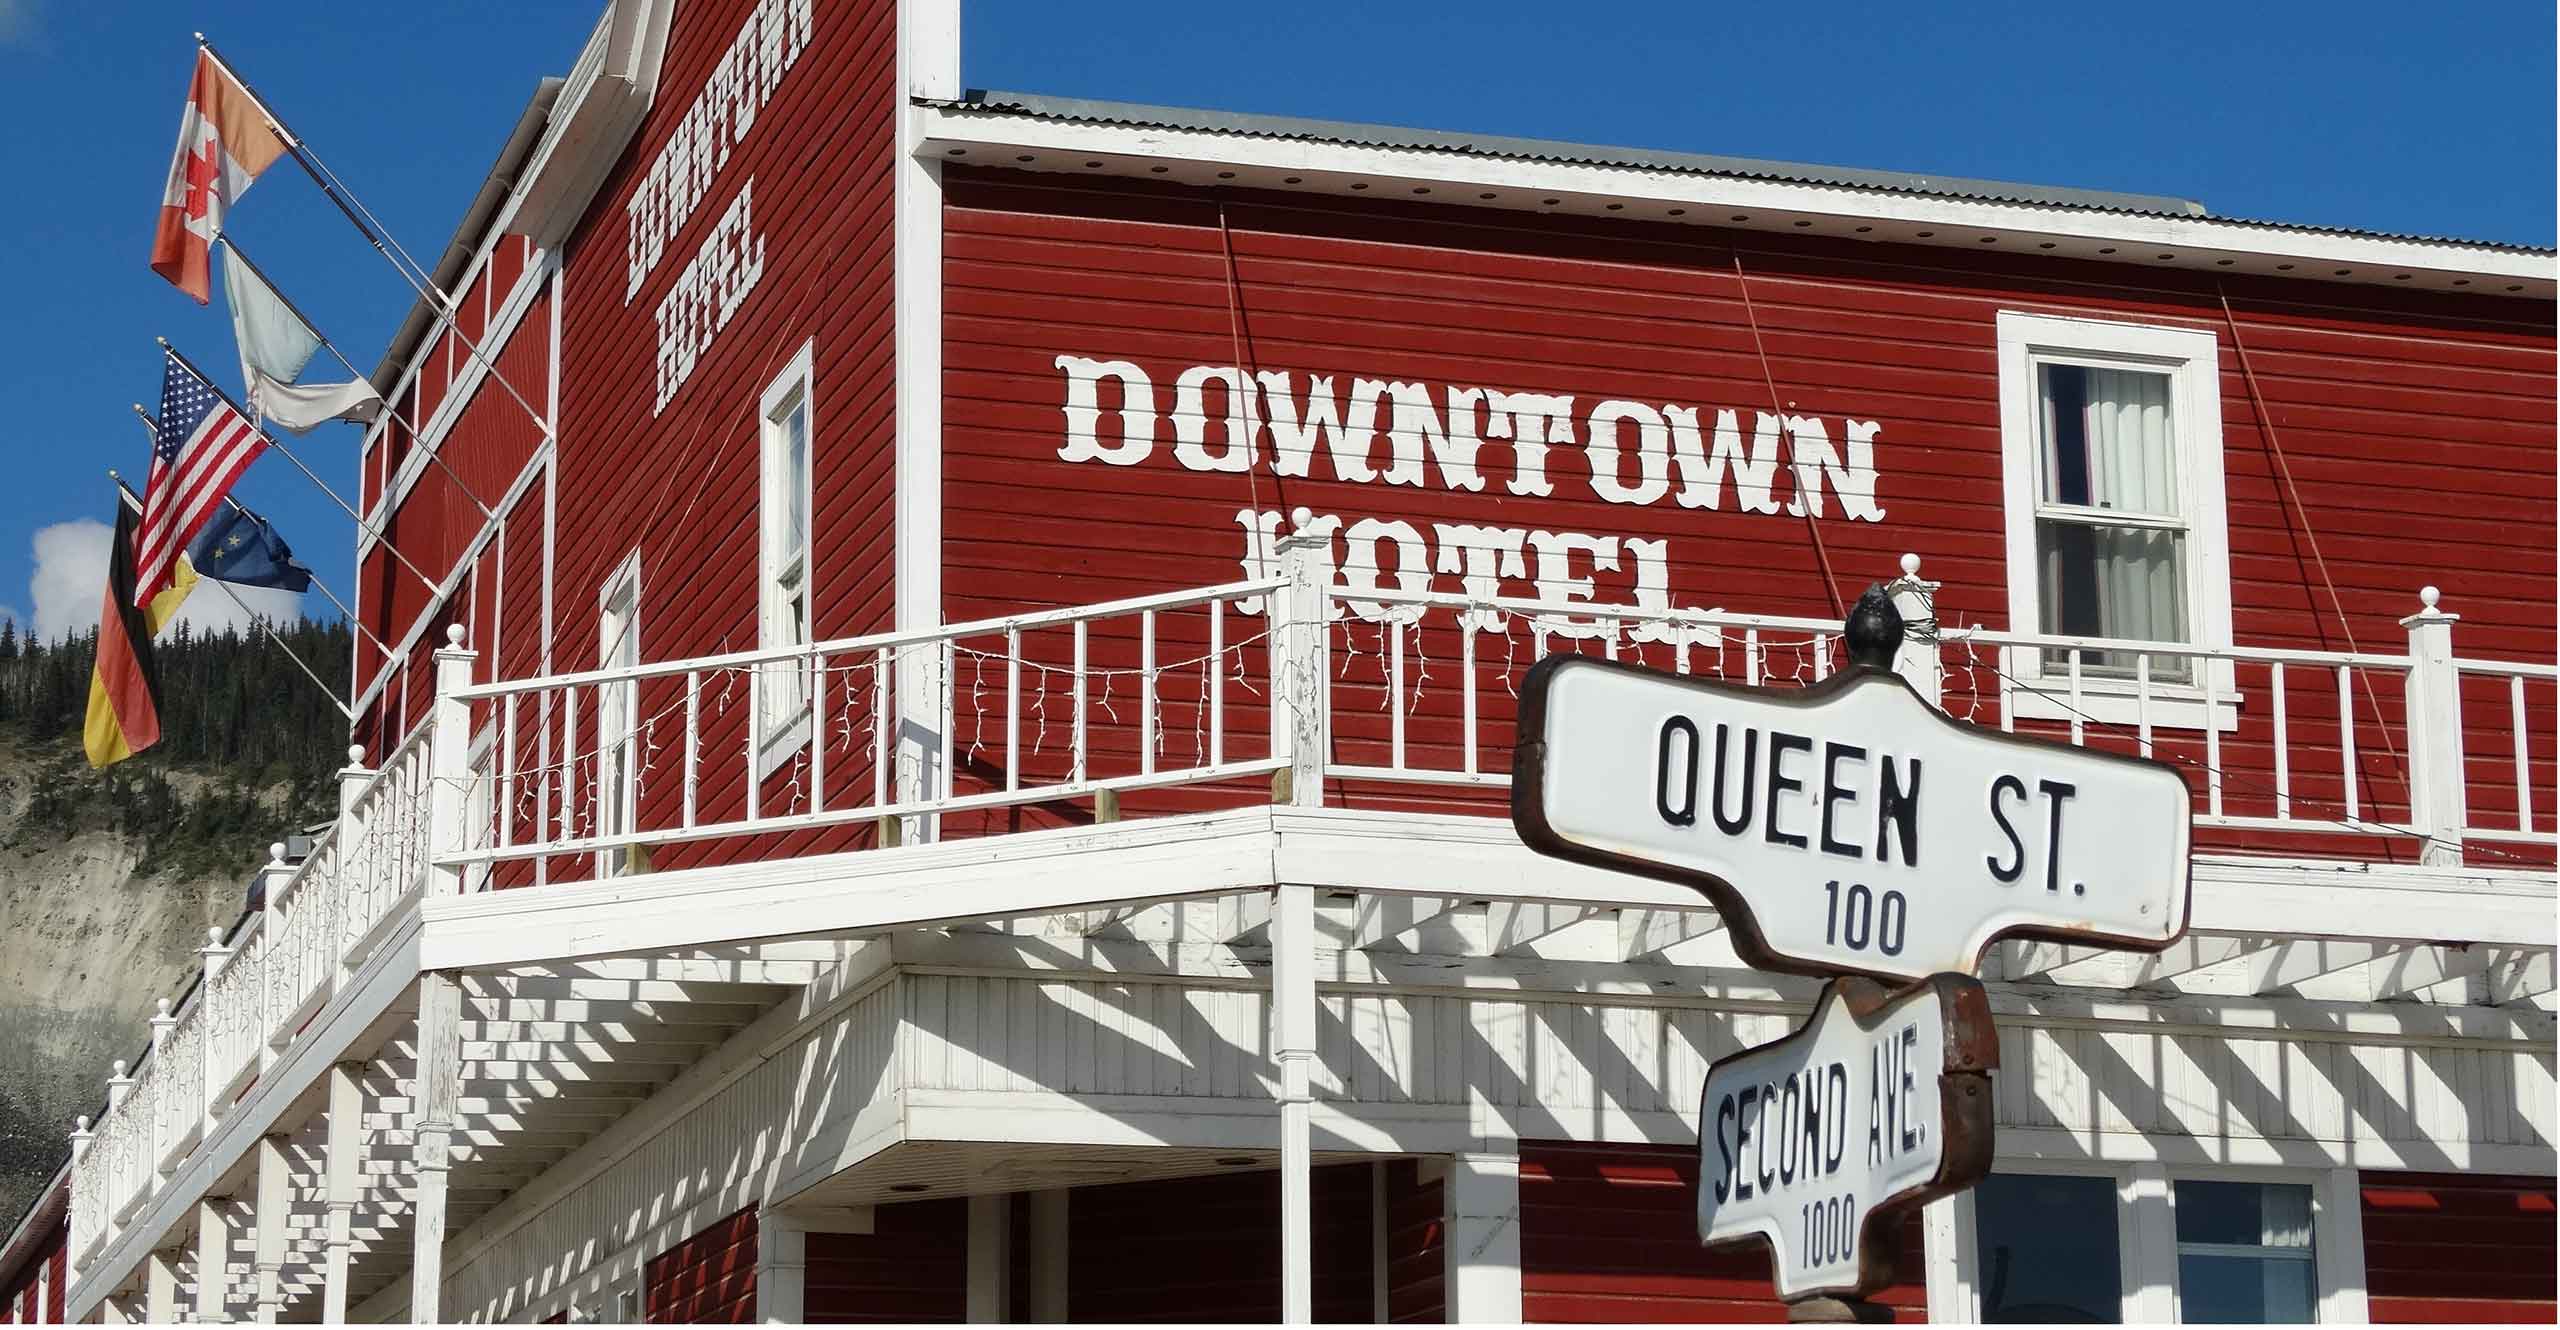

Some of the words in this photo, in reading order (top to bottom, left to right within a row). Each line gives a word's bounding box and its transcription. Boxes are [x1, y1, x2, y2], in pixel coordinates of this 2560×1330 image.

[654, 174, 765, 419] HOTEL
[1055, 354, 1886, 522] DOWNTOWN
[1656, 714, 1922, 867] QUEEN
[1986, 775, 2086, 895] ST.
[1825, 880, 1906, 956] 100
[1715, 1062, 1847, 1205] SECOND
[1868, 1022, 1927, 1169] AVE.
[1803, 1193, 1855, 1269] 1000
